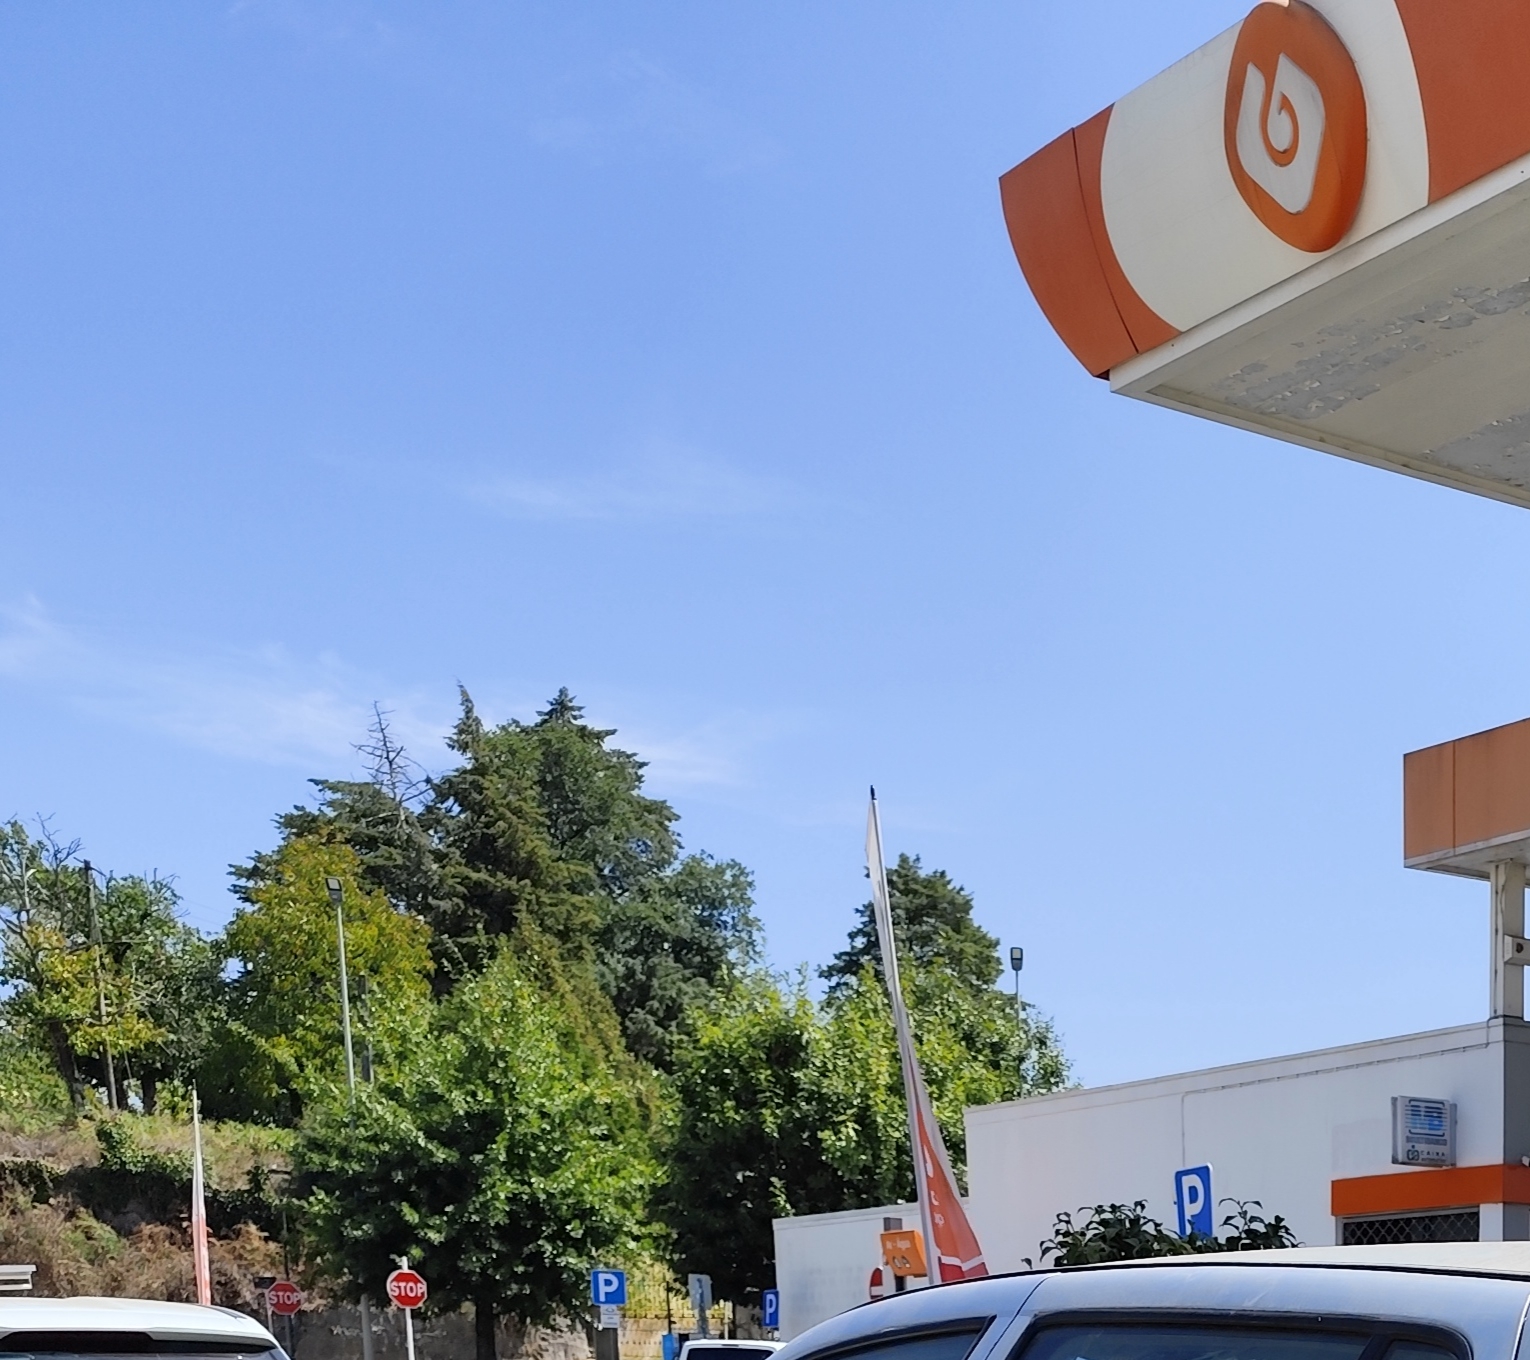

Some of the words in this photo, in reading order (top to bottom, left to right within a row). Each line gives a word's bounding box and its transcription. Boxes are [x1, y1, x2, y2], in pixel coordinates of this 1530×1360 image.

[1181, 1173, 1205, 1236] P
[269, 1291, 302, 1305] STOP
[390, 1281, 426, 1298] STOP
[599, 1272, 619, 1302] P
[765, 1293, 776, 1324] P
